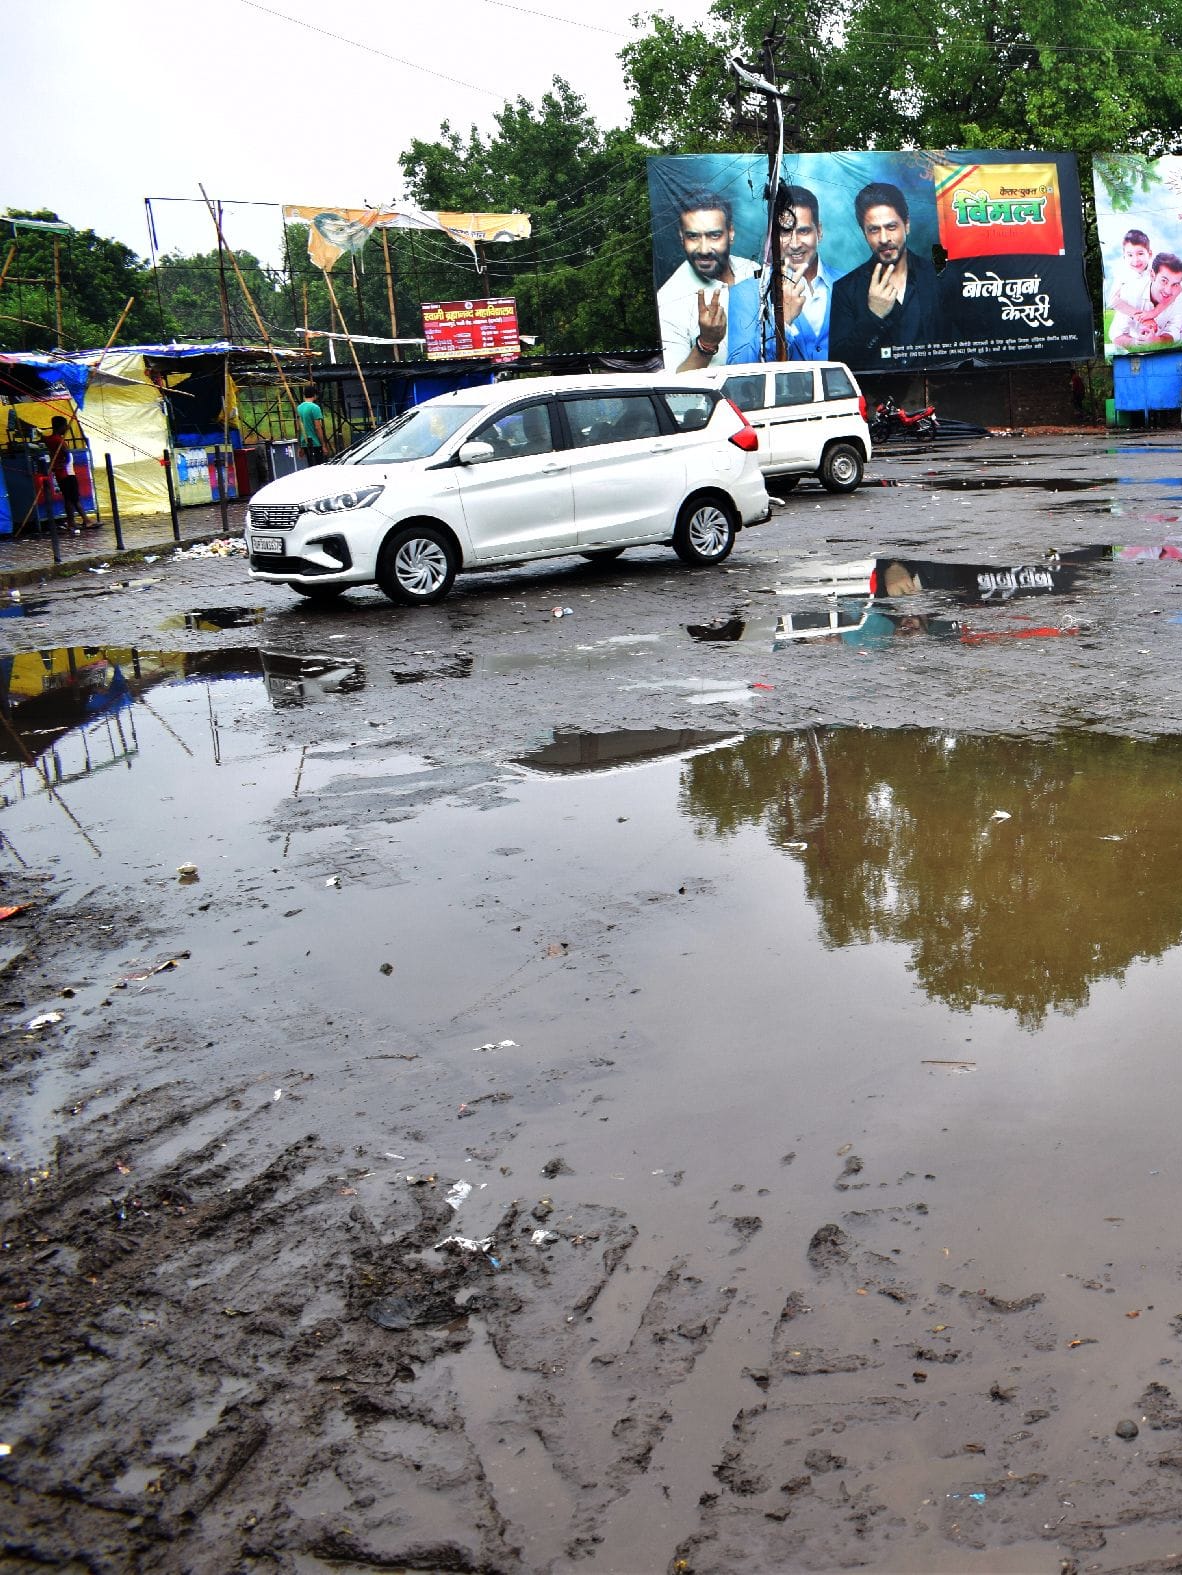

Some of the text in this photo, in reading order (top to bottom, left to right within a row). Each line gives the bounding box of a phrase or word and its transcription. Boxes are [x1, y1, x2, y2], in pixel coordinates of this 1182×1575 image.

[962, 271, 1042, 302] बोलो जुबां
[998, 294, 1055, 328] केसरी
